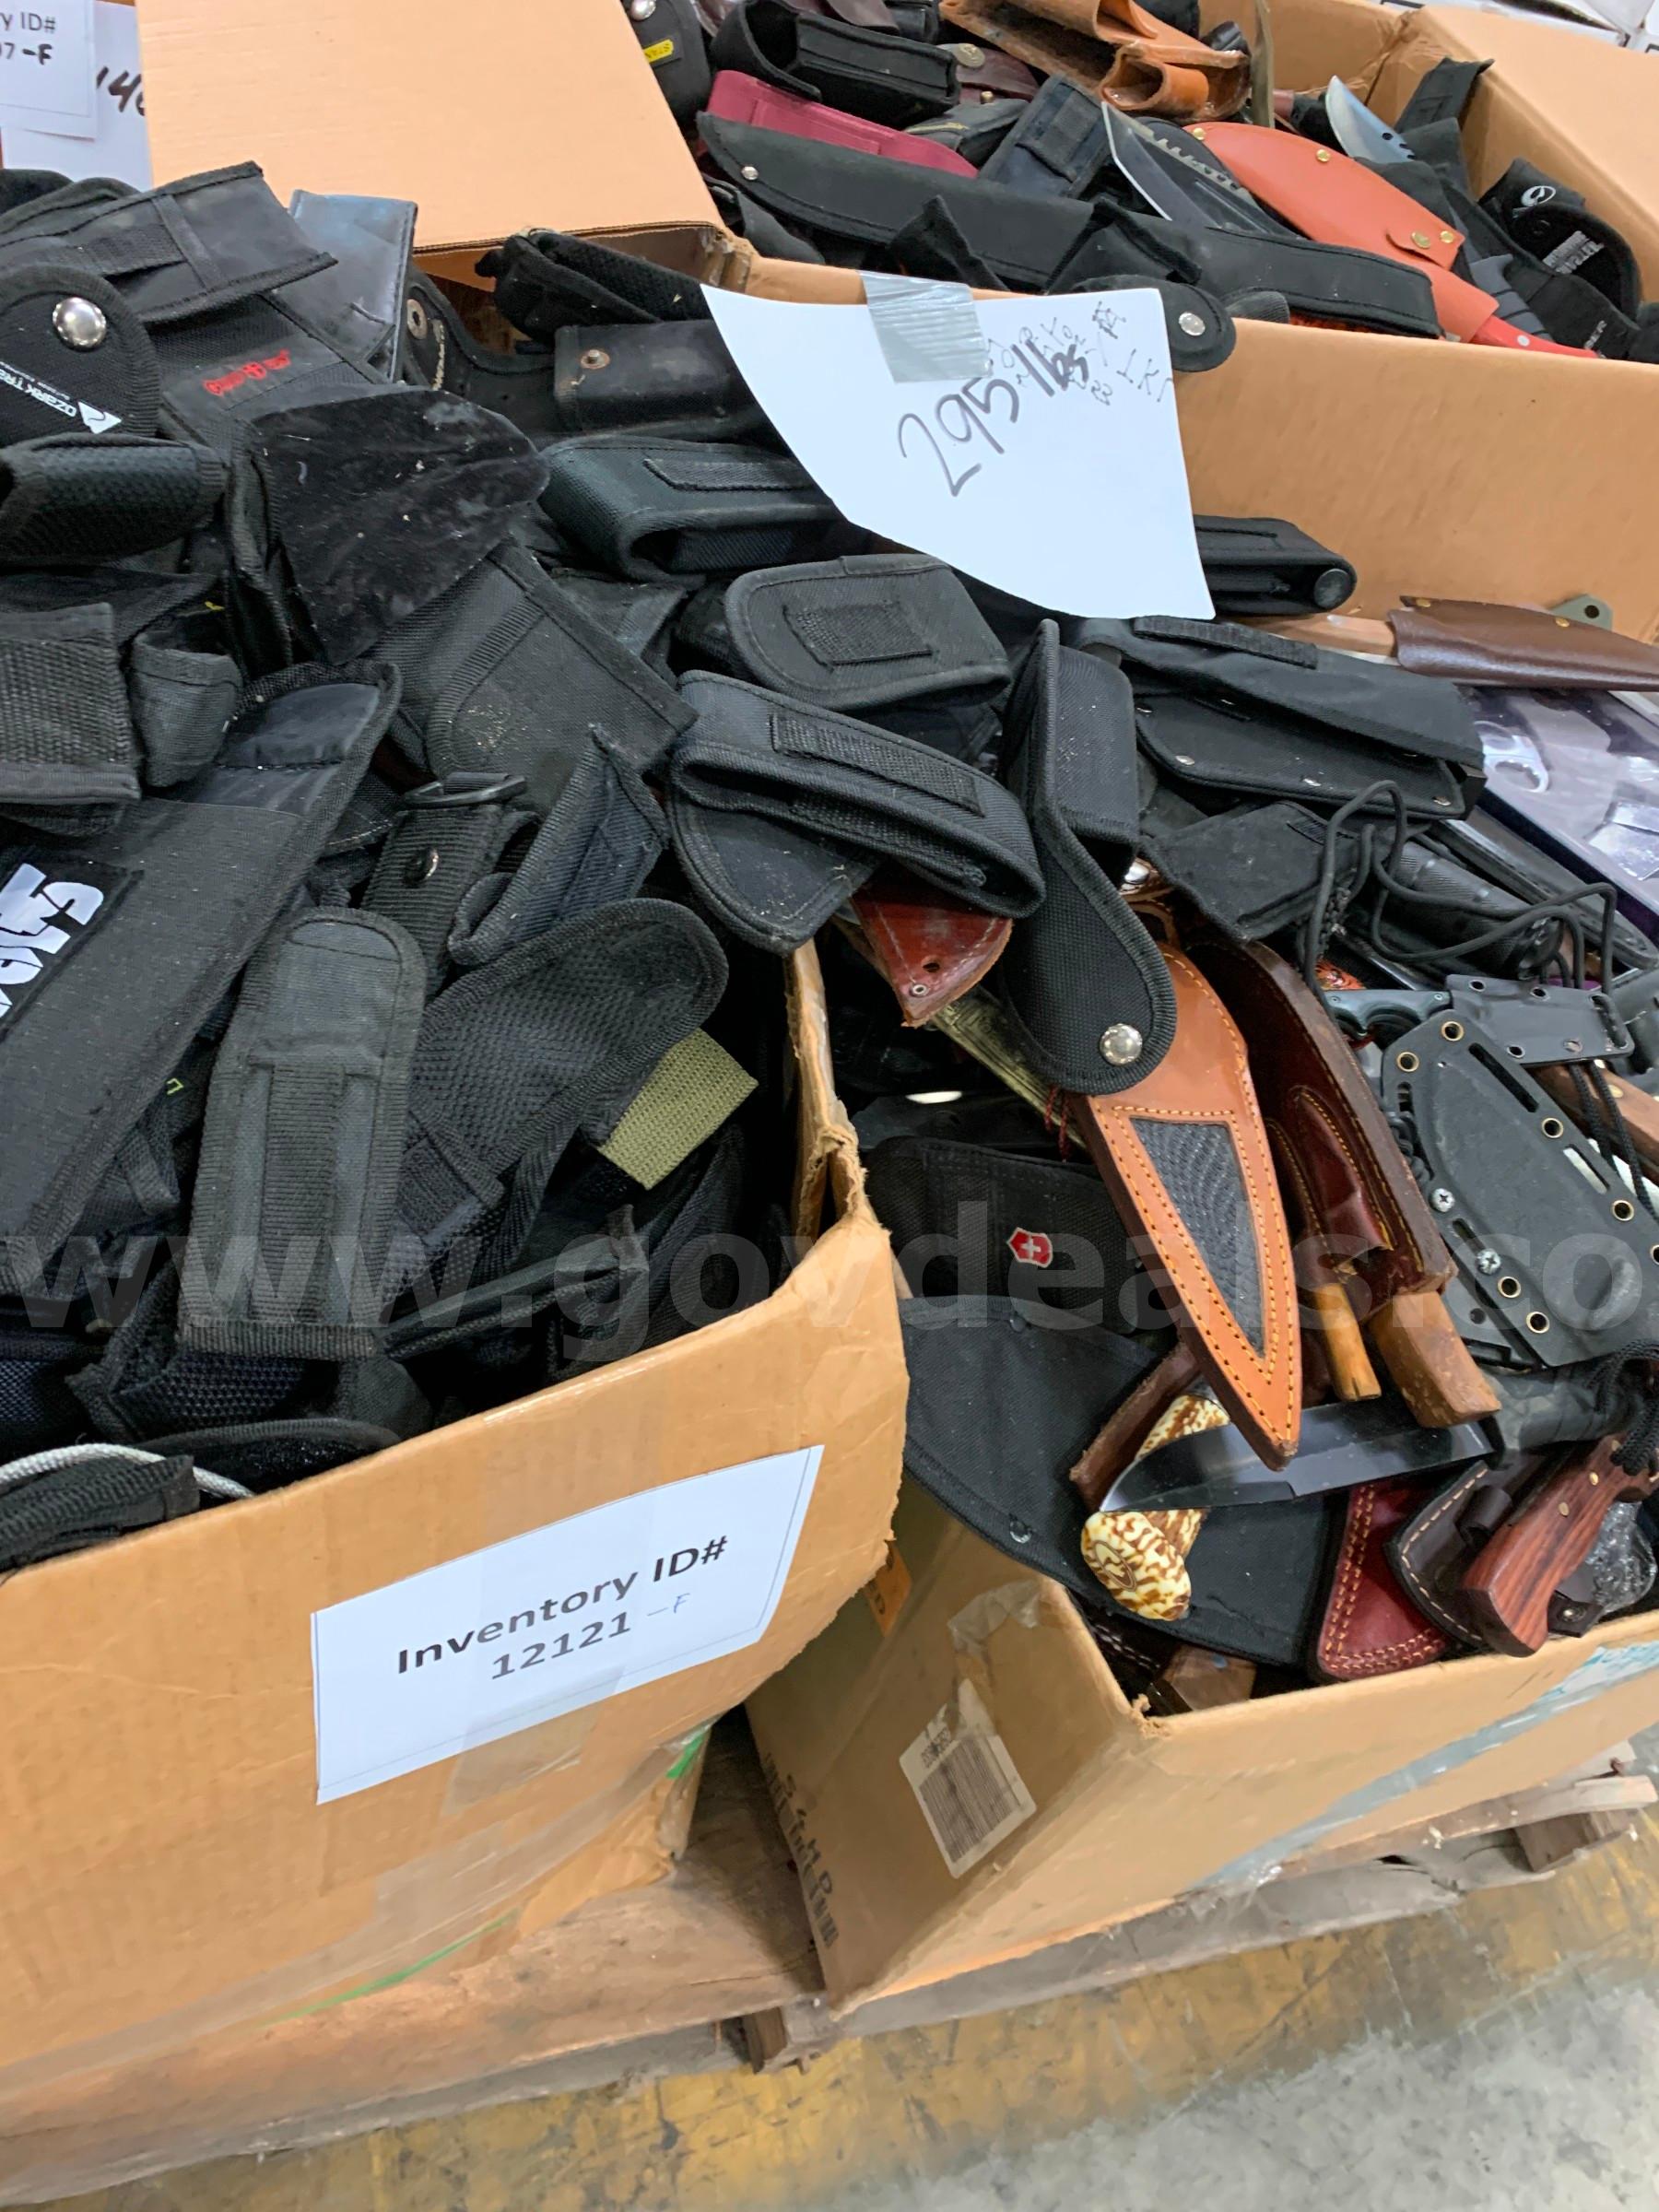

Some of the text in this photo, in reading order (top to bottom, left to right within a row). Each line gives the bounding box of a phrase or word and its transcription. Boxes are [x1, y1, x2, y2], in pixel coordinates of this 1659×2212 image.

[21, 12, 55, 33] ID#
[398, 1535, 728, 1674] Inventory ID#
[491, 1611, 632, 1680] 12121
